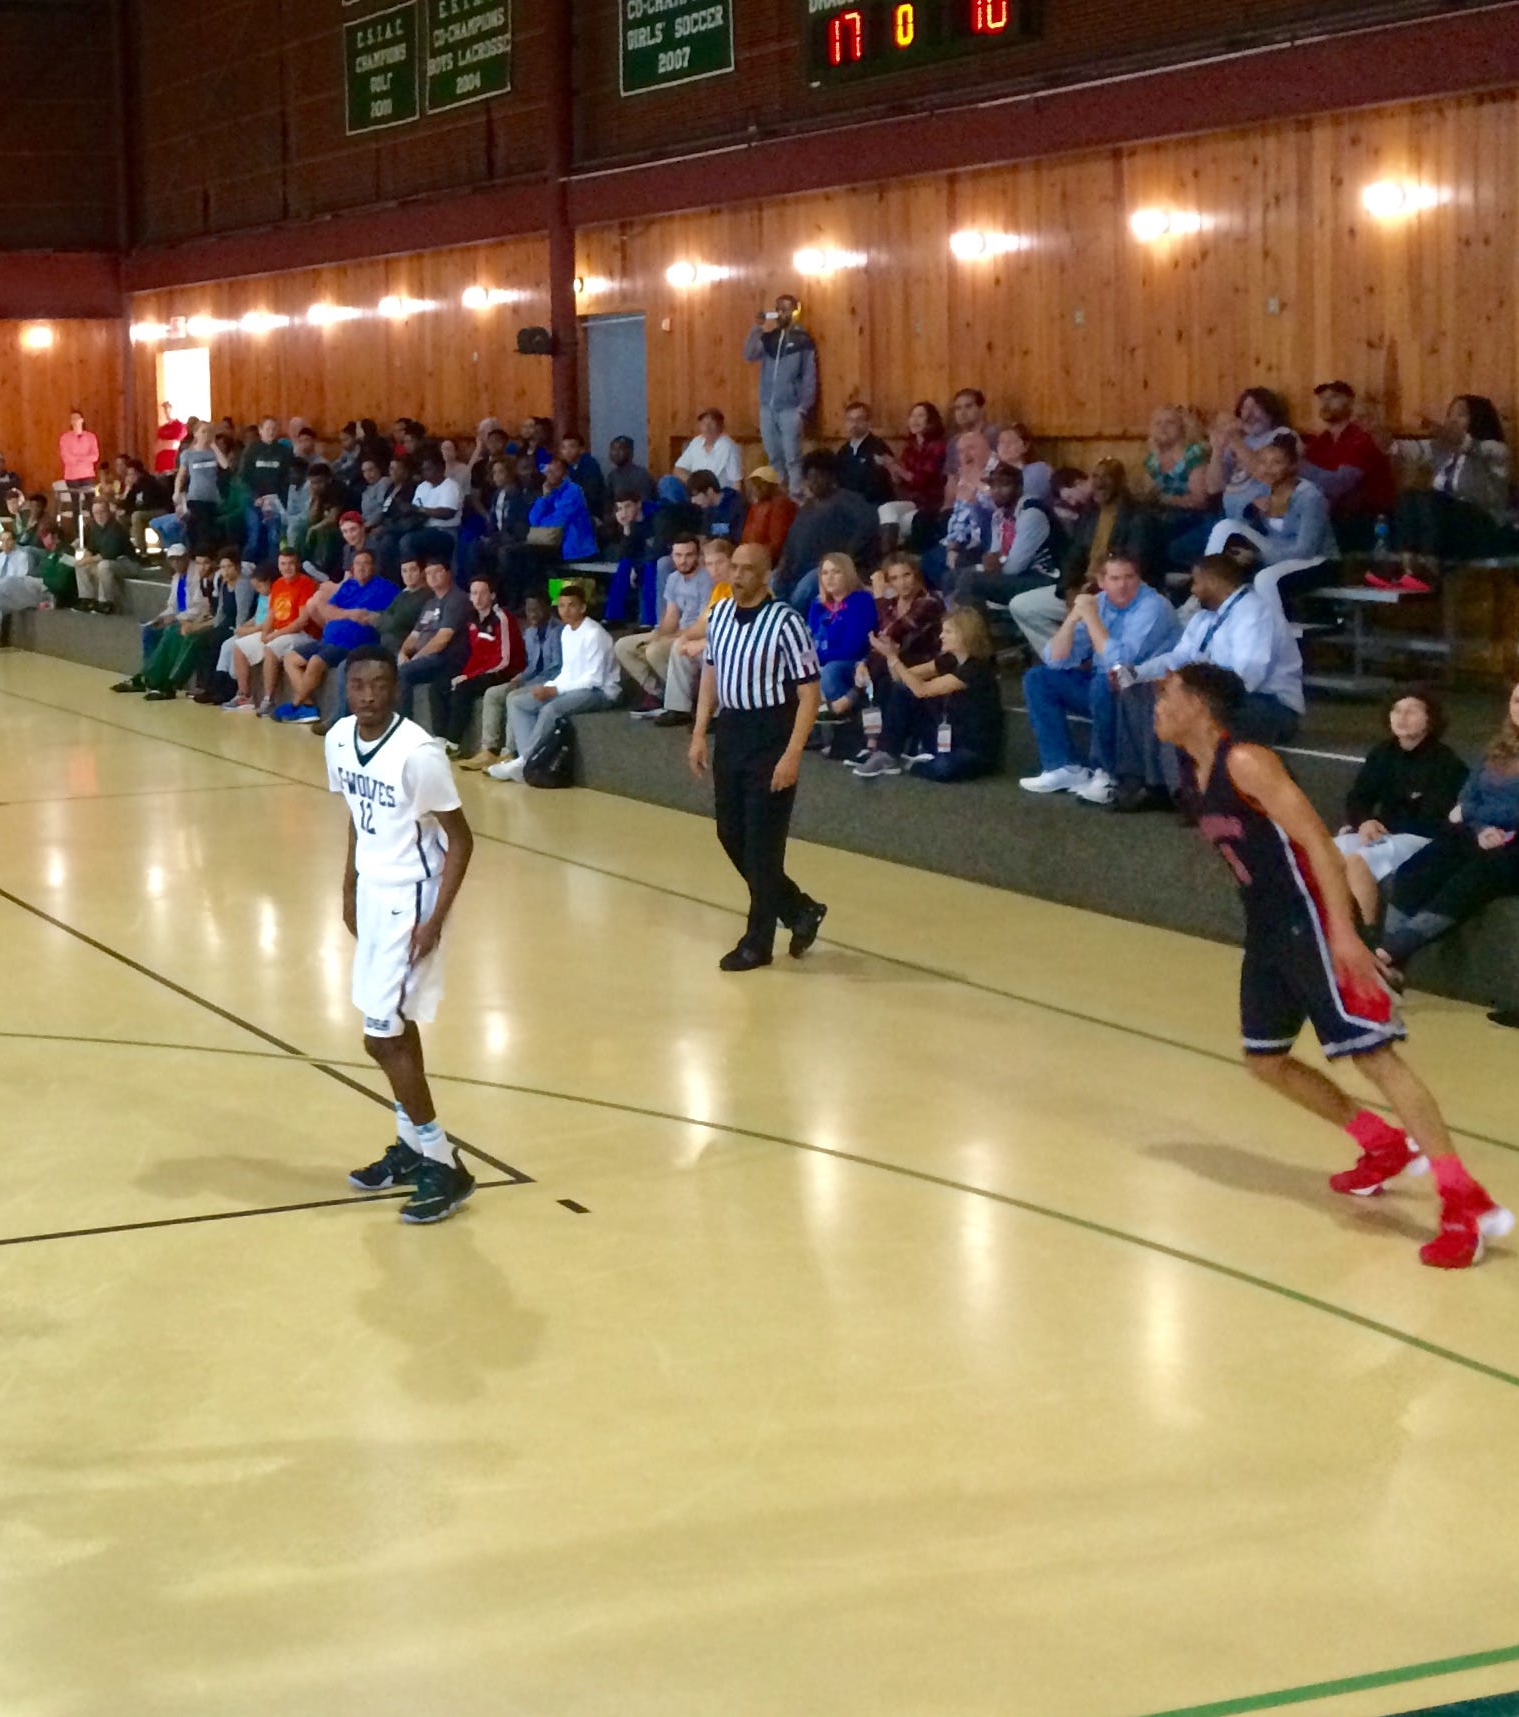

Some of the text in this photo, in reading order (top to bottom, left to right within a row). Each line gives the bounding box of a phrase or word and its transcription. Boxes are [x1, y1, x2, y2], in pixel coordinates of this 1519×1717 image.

[626, 4, 724, 51] GIRLS' SOCCER
[834, 12, 862, 62] 17
[896, 3, 915, 46] 0
[657, 46, 691, 75] 2007
[359, 799, 377, 835] 12
